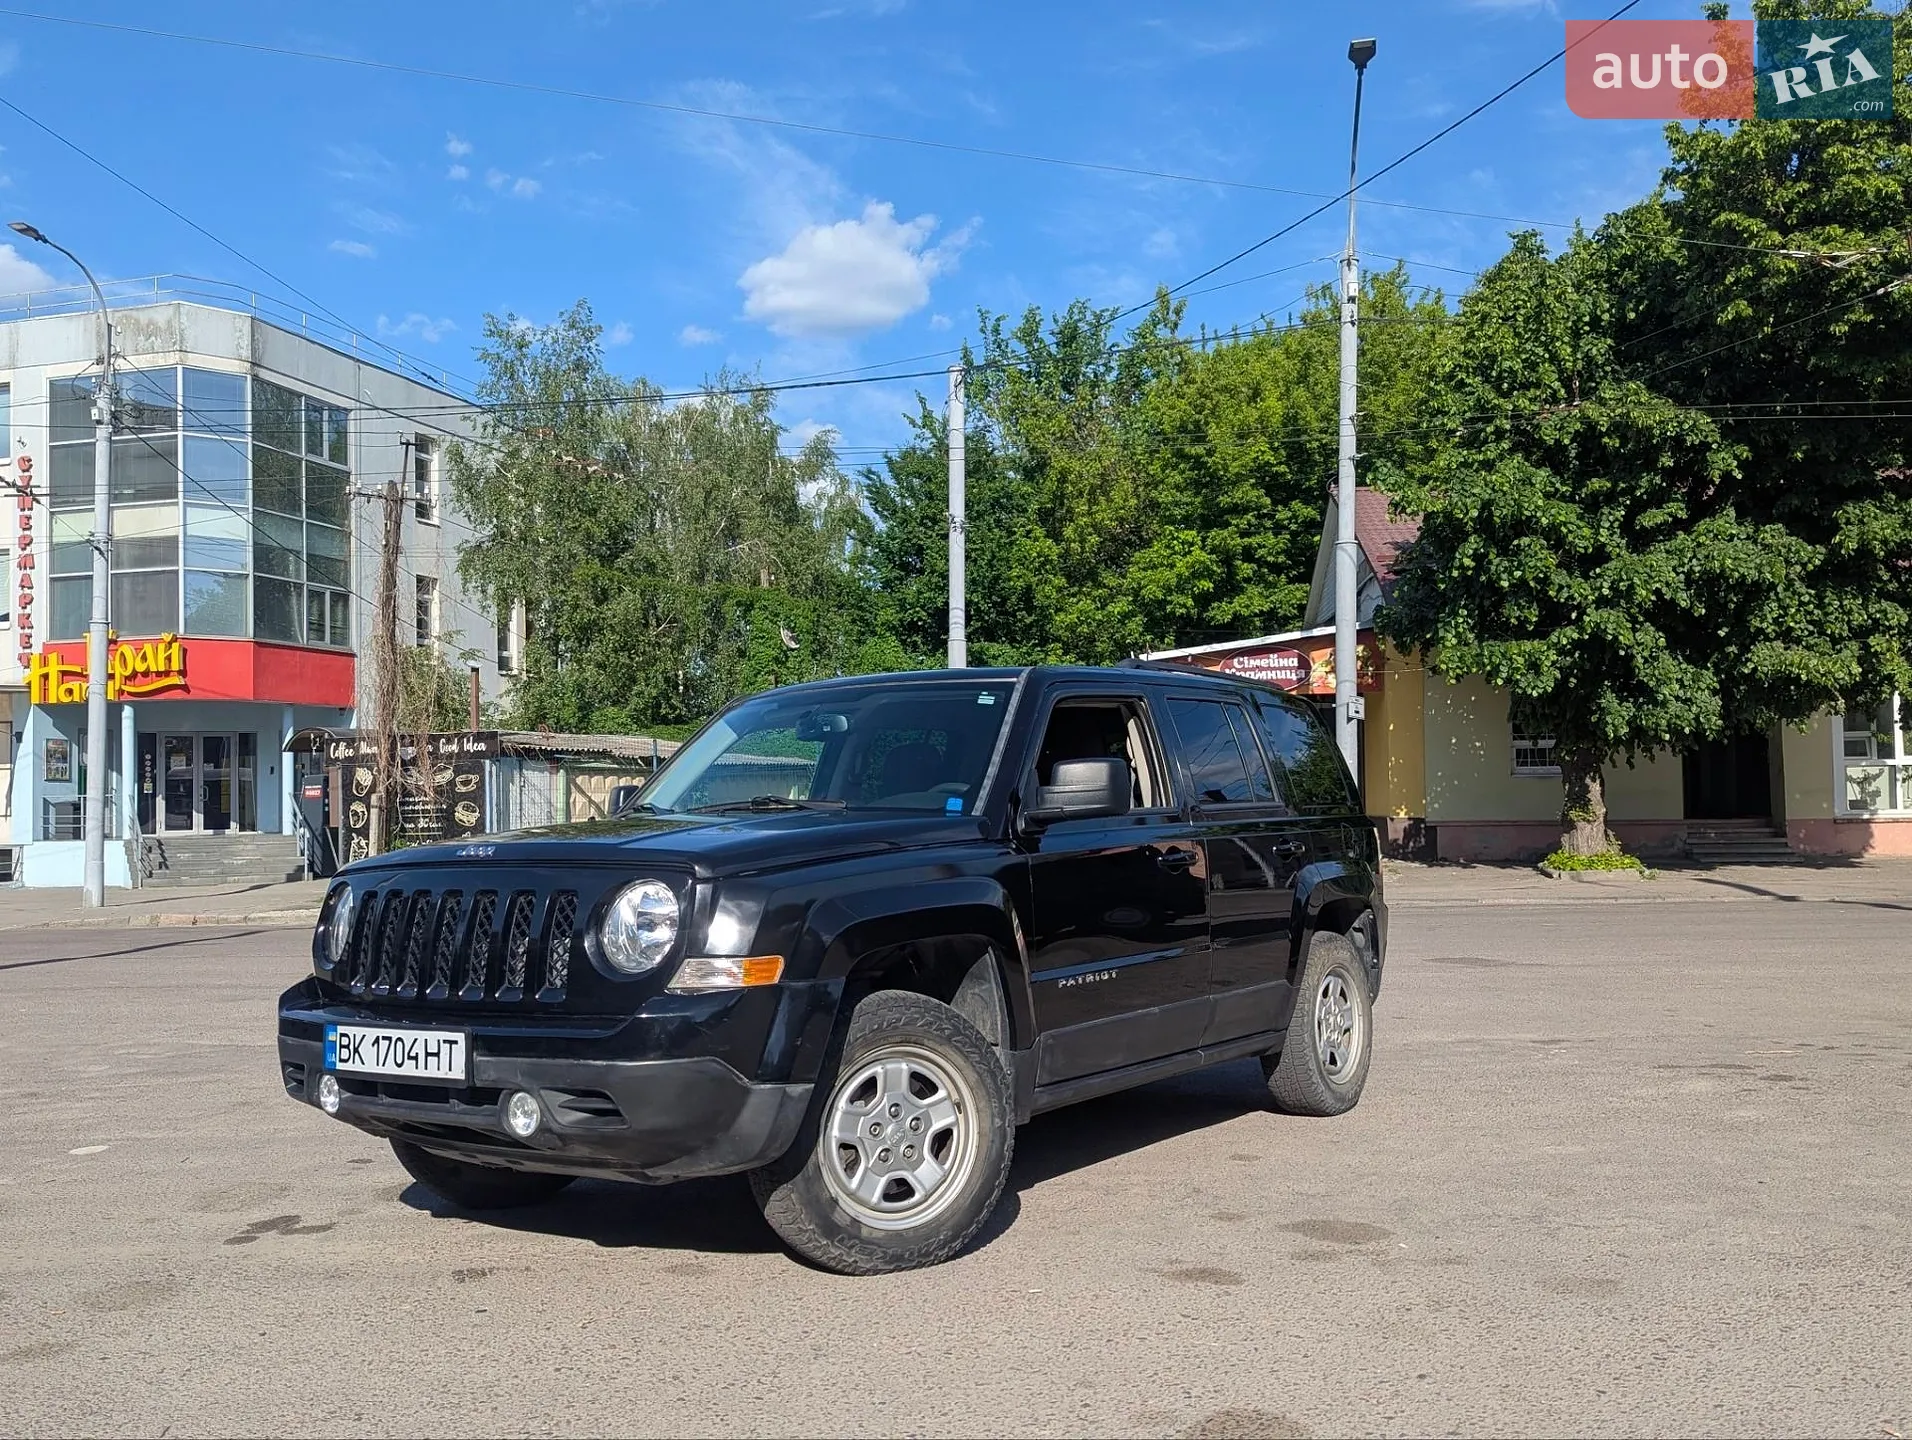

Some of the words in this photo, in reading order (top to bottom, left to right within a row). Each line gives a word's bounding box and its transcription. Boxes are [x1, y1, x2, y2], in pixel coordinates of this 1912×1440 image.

[17, 455, 36, 669] СУПЕРМАРКЕТ
[1233, 653, 1299, 669] Сімейна
[330, 742, 355, 759] Coffee
[439, 738, 460, 753] Good
[463, 735, 487, 753] Idea
[1058, 969, 1119, 988] PATRIOT
[338, 1032, 367, 1066] BK
[371, 1035, 419, 1070] 1704
[424, 1038, 459, 1072] HT
